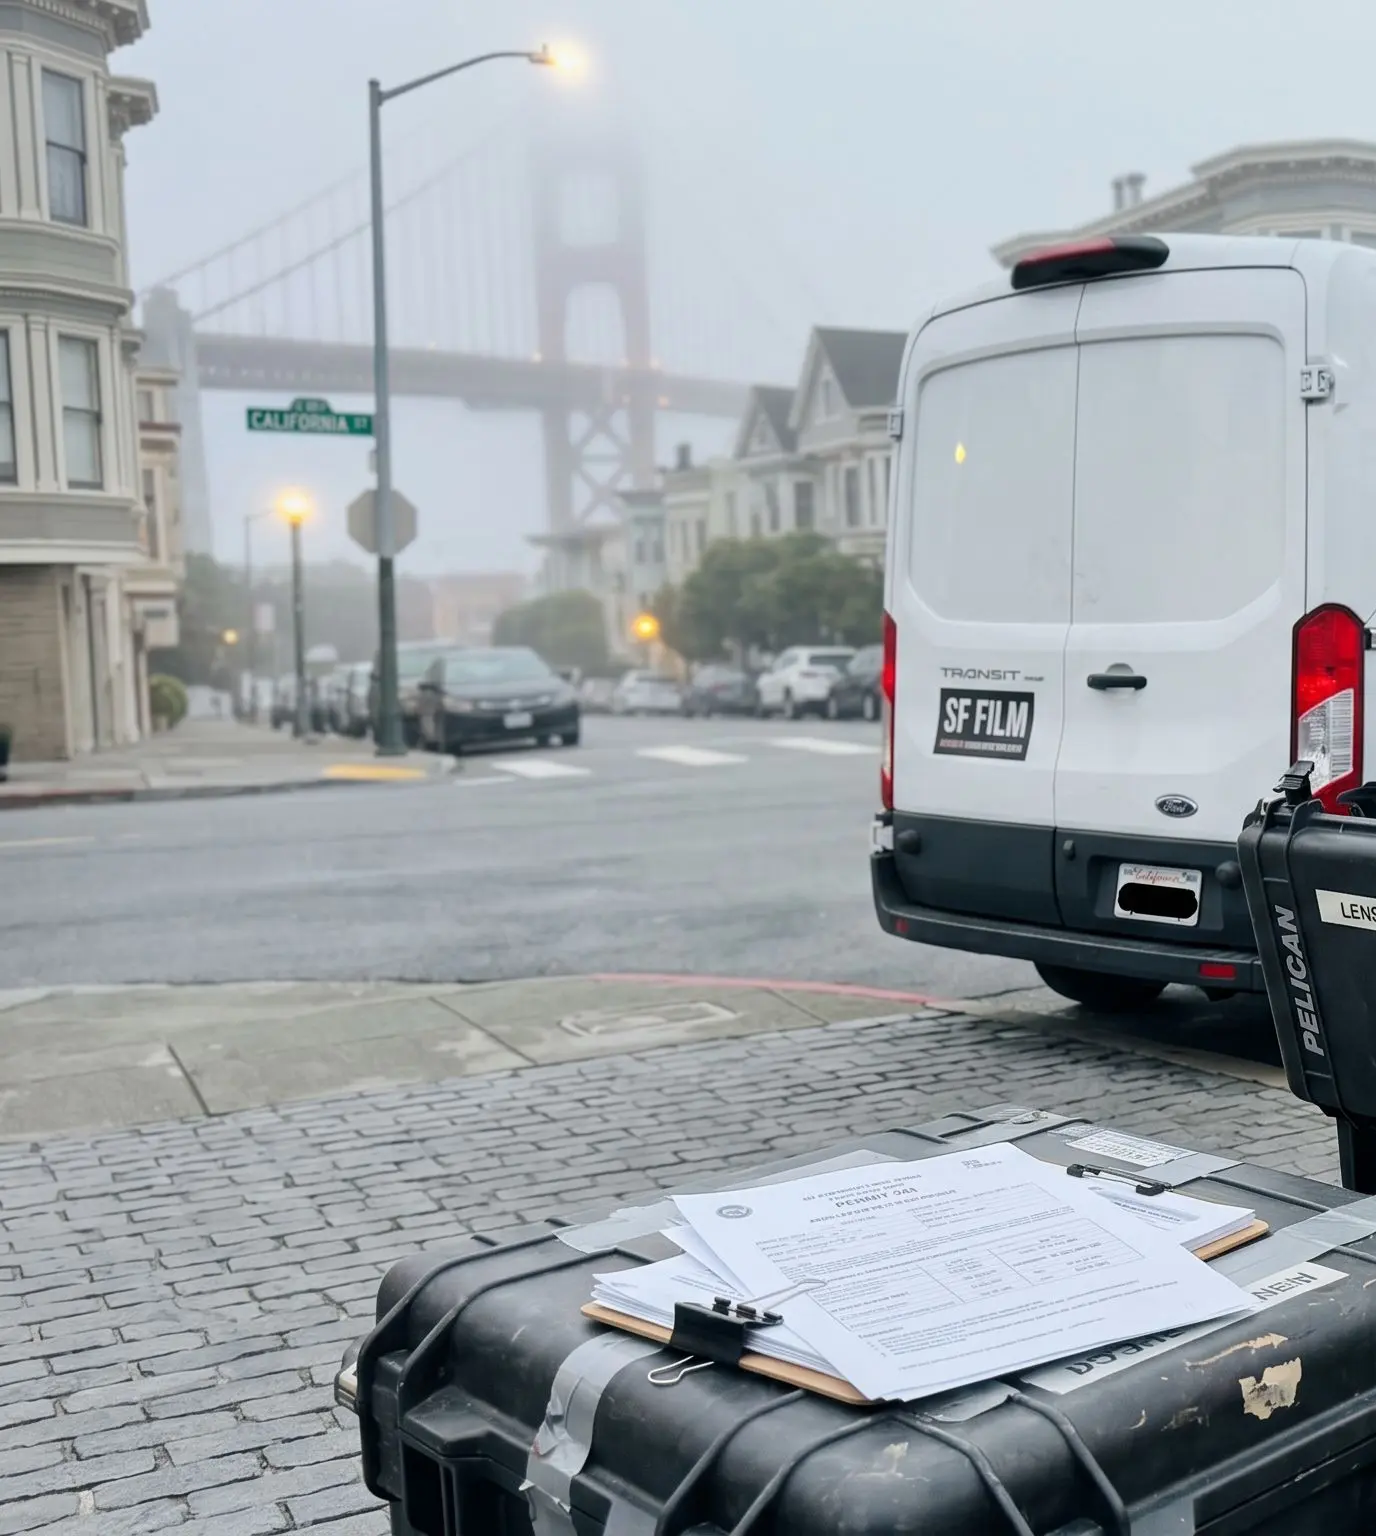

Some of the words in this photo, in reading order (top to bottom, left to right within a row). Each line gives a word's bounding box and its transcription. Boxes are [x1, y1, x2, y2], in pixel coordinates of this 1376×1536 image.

[251, 411, 349, 432] CALIFORNIA
[940, 667, 1020, 681] TRANSIT
[943, 696, 972, 734] SF
[973, 698, 1029, 738] FILM
[1163, 799, 1187, 813] Ford
[1274, 904, 1325, 1057] PELICAN
